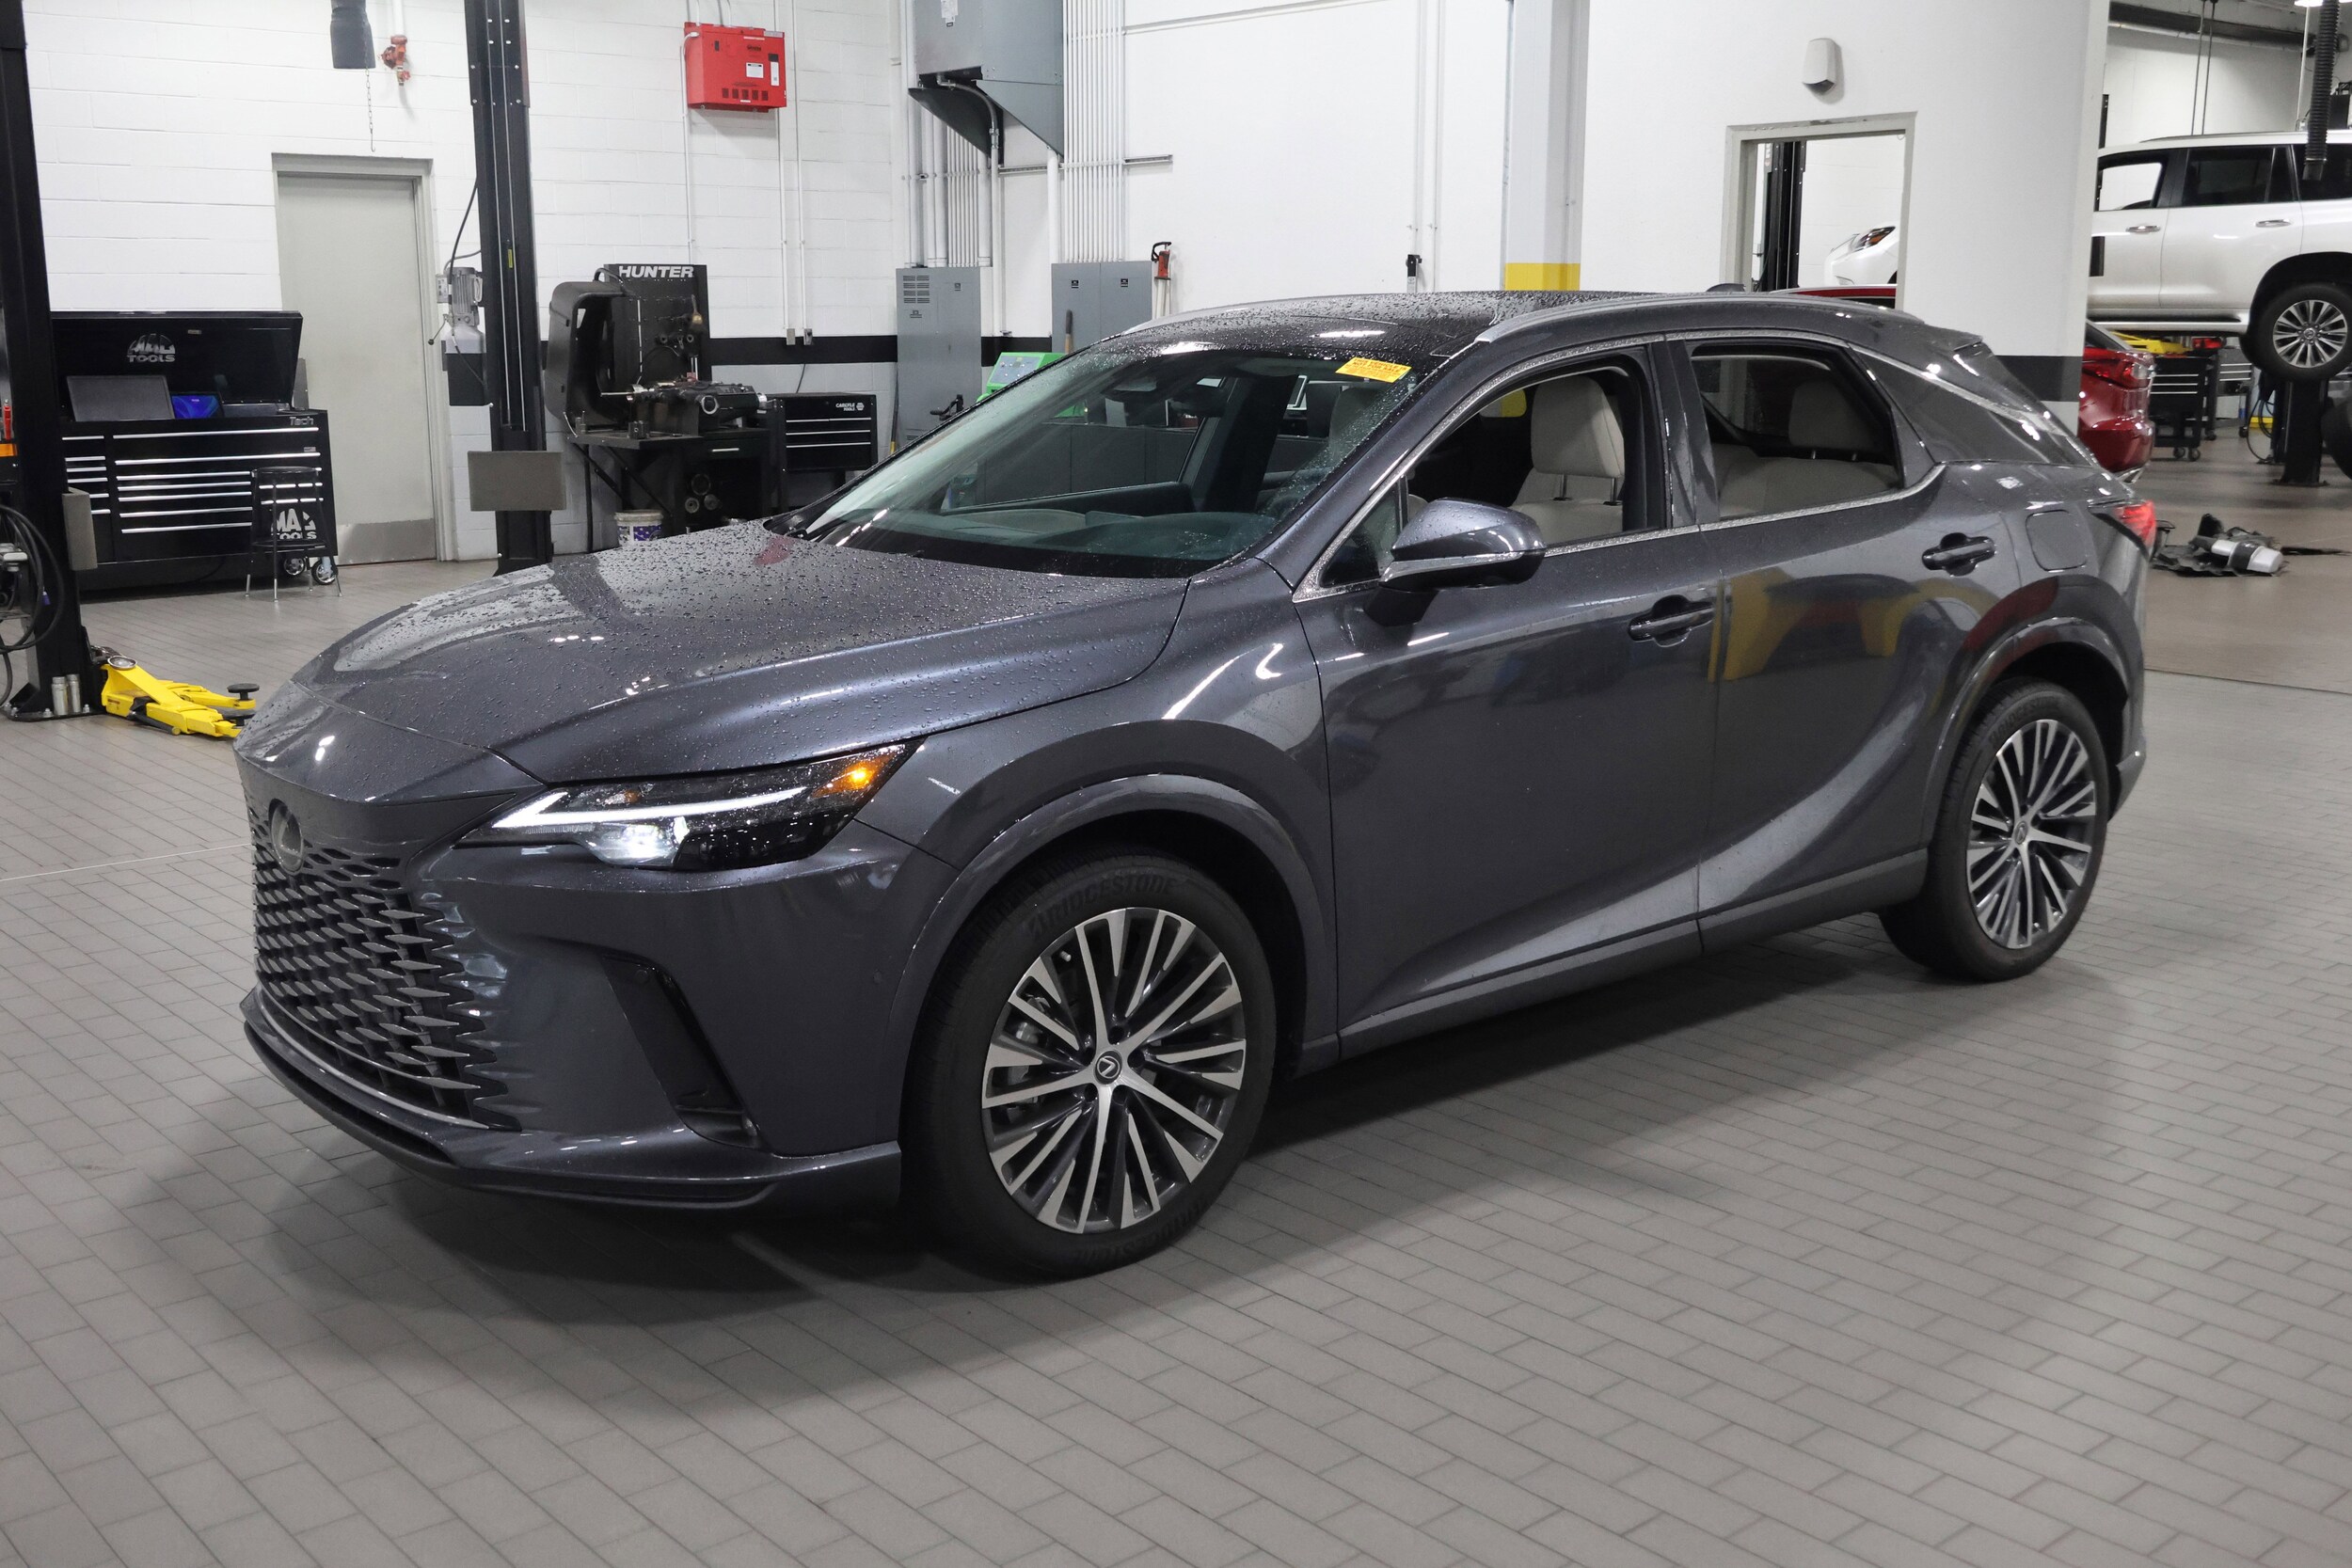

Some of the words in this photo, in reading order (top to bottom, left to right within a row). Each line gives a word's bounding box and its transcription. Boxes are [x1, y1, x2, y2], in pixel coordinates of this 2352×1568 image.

[618, 265, 694, 277] HUNTER
[127, 355, 176, 363] TOOLS
[290, 416, 314, 425] Tech
[271, 531, 317, 540] OOS
